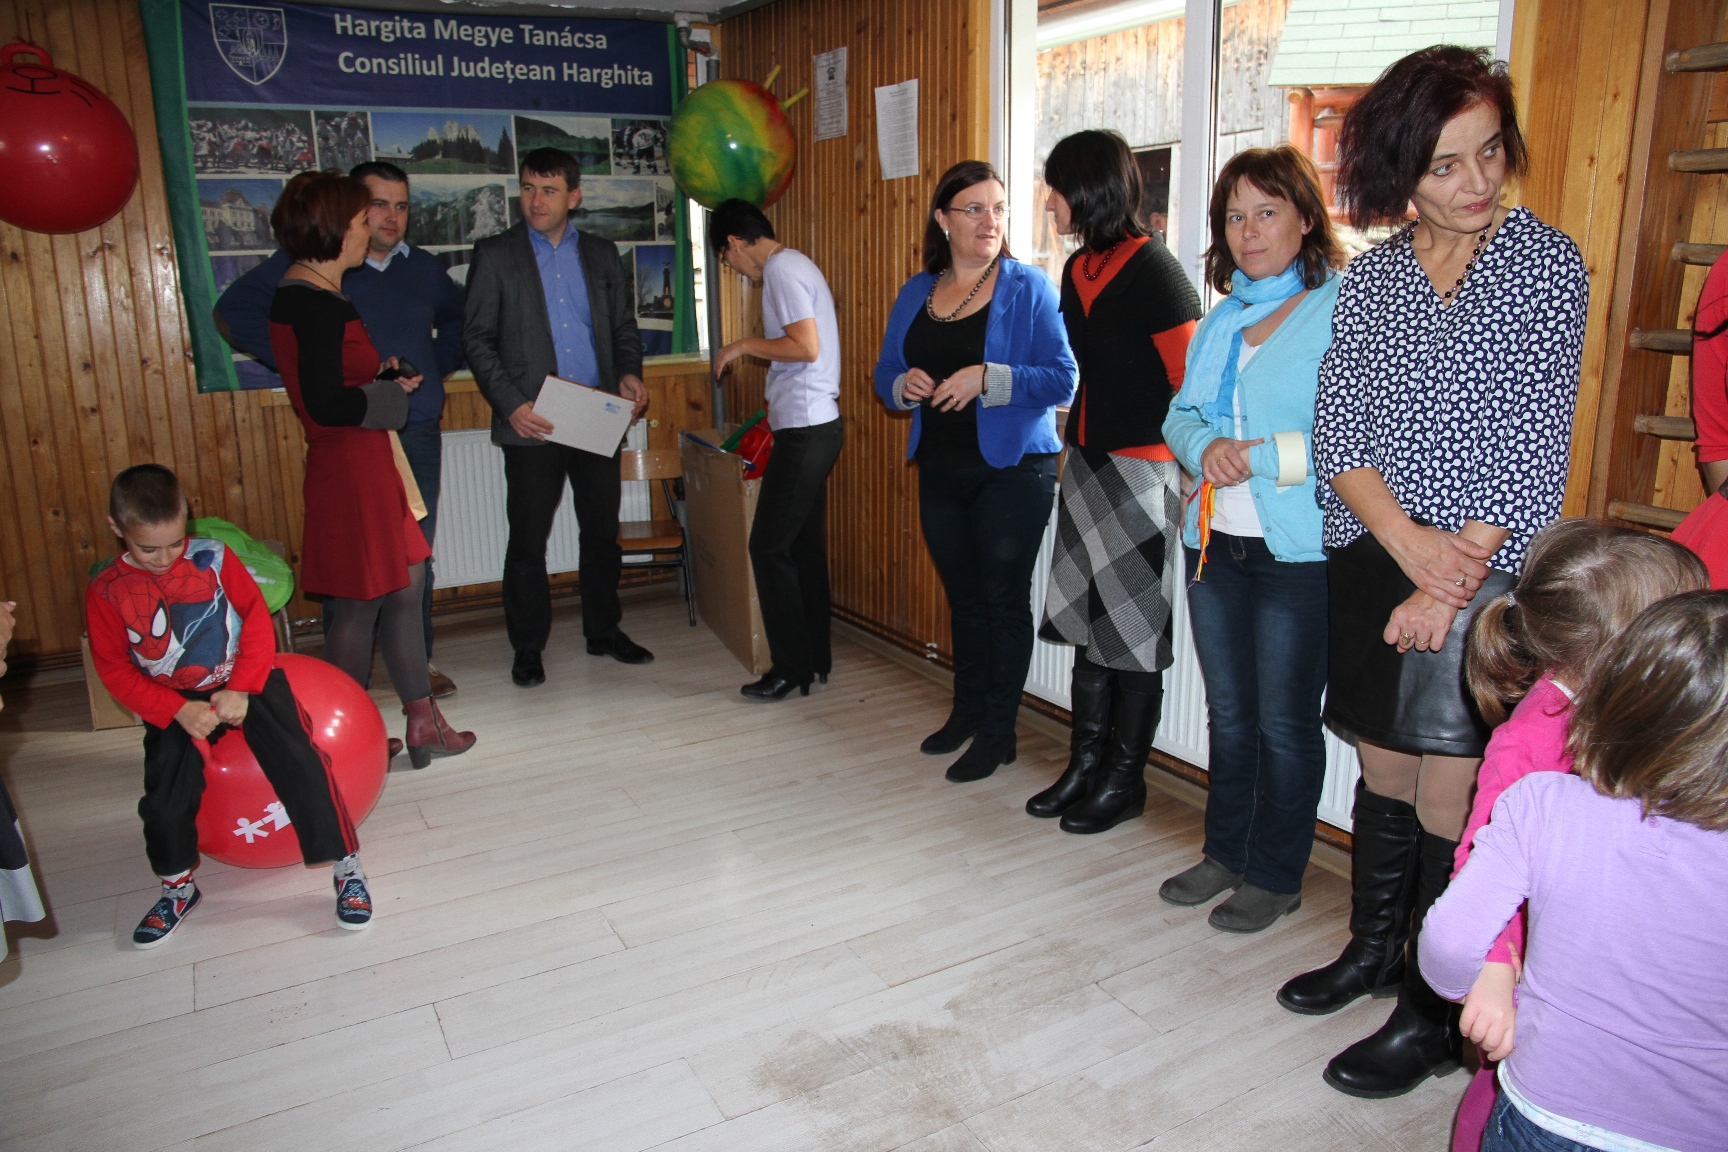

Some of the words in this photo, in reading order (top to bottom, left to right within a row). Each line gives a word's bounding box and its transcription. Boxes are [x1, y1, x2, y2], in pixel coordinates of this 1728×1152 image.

[334, 13, 426, 43] Hargita
[434, 19, 514, 48] Megye
[519, 24, 607, 49] Tanácsa
[338, 51, 444, 79] Consiliul
[450, 56, 556, 84] Județean
[562, 62, 653, 89] Harghita
